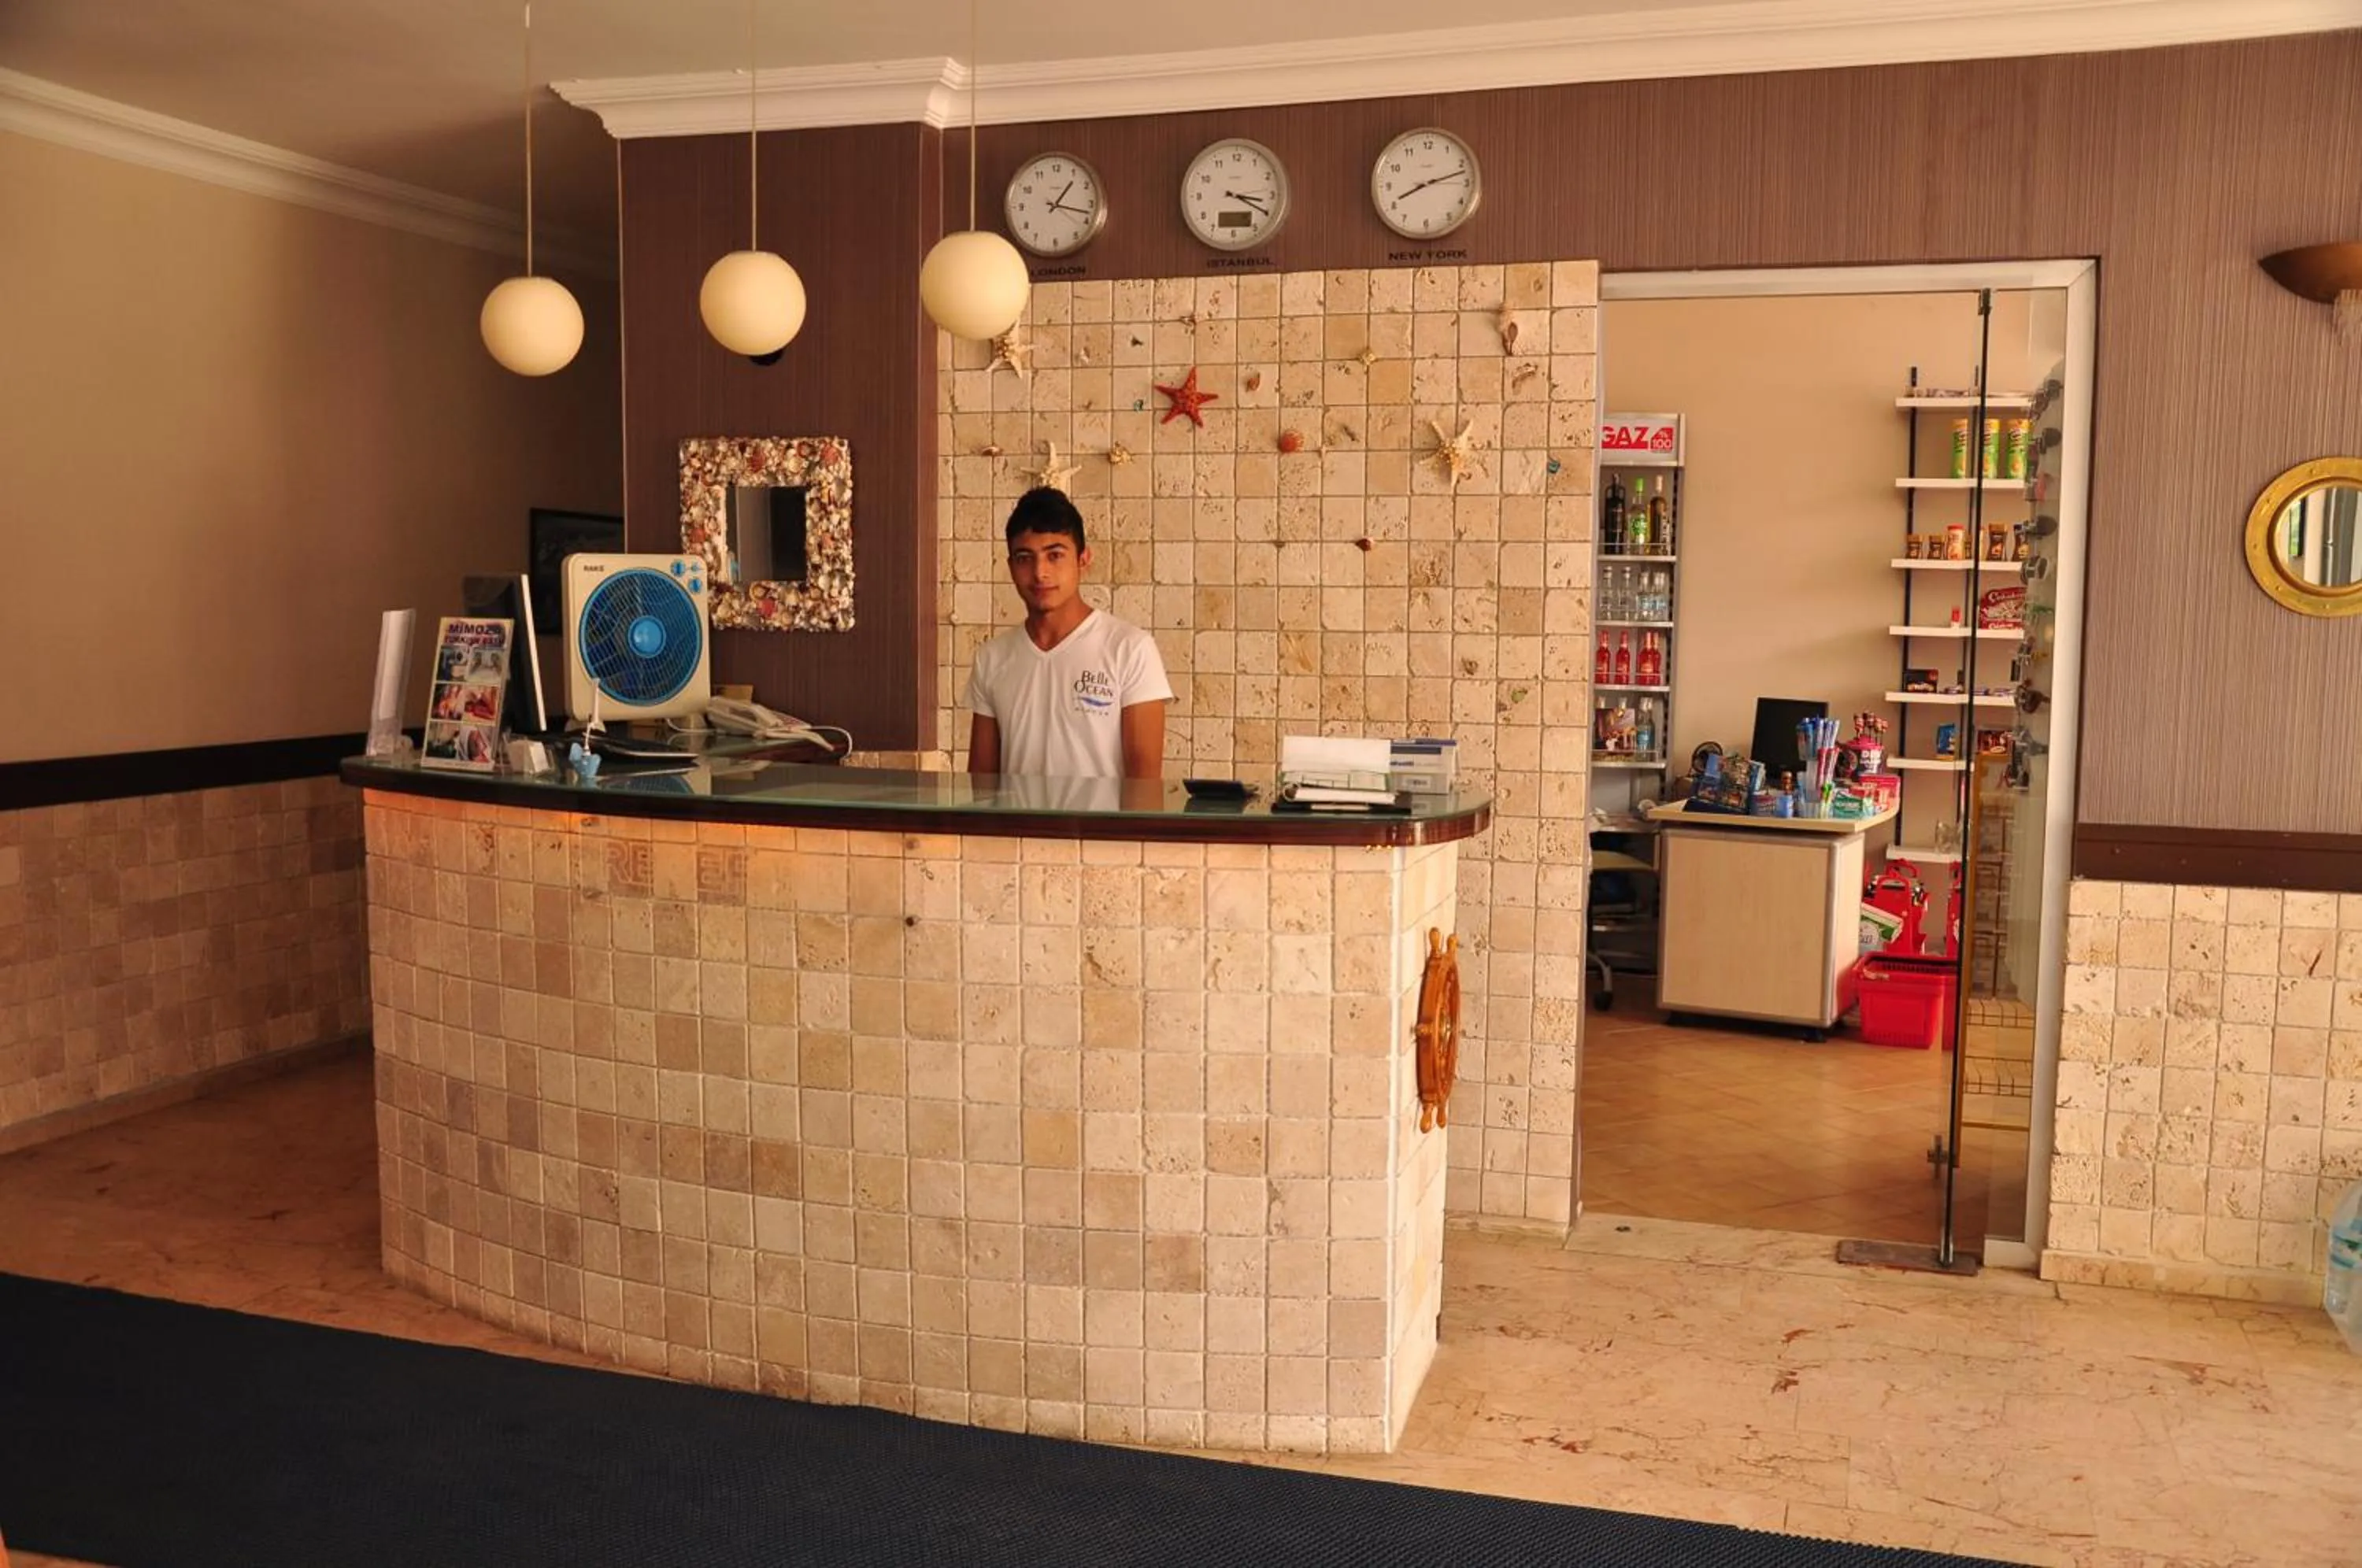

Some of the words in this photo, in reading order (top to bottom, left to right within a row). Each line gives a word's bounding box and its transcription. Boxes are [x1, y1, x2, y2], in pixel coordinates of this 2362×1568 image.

[1405, 149, 1413, 157] 11
[1390, 164, 1401, 172] 10
[1389, 251, 1422, 261] NEW
[1427, 249, 1468, 259] YORK
[1652, 438, 1672, 449] 100
